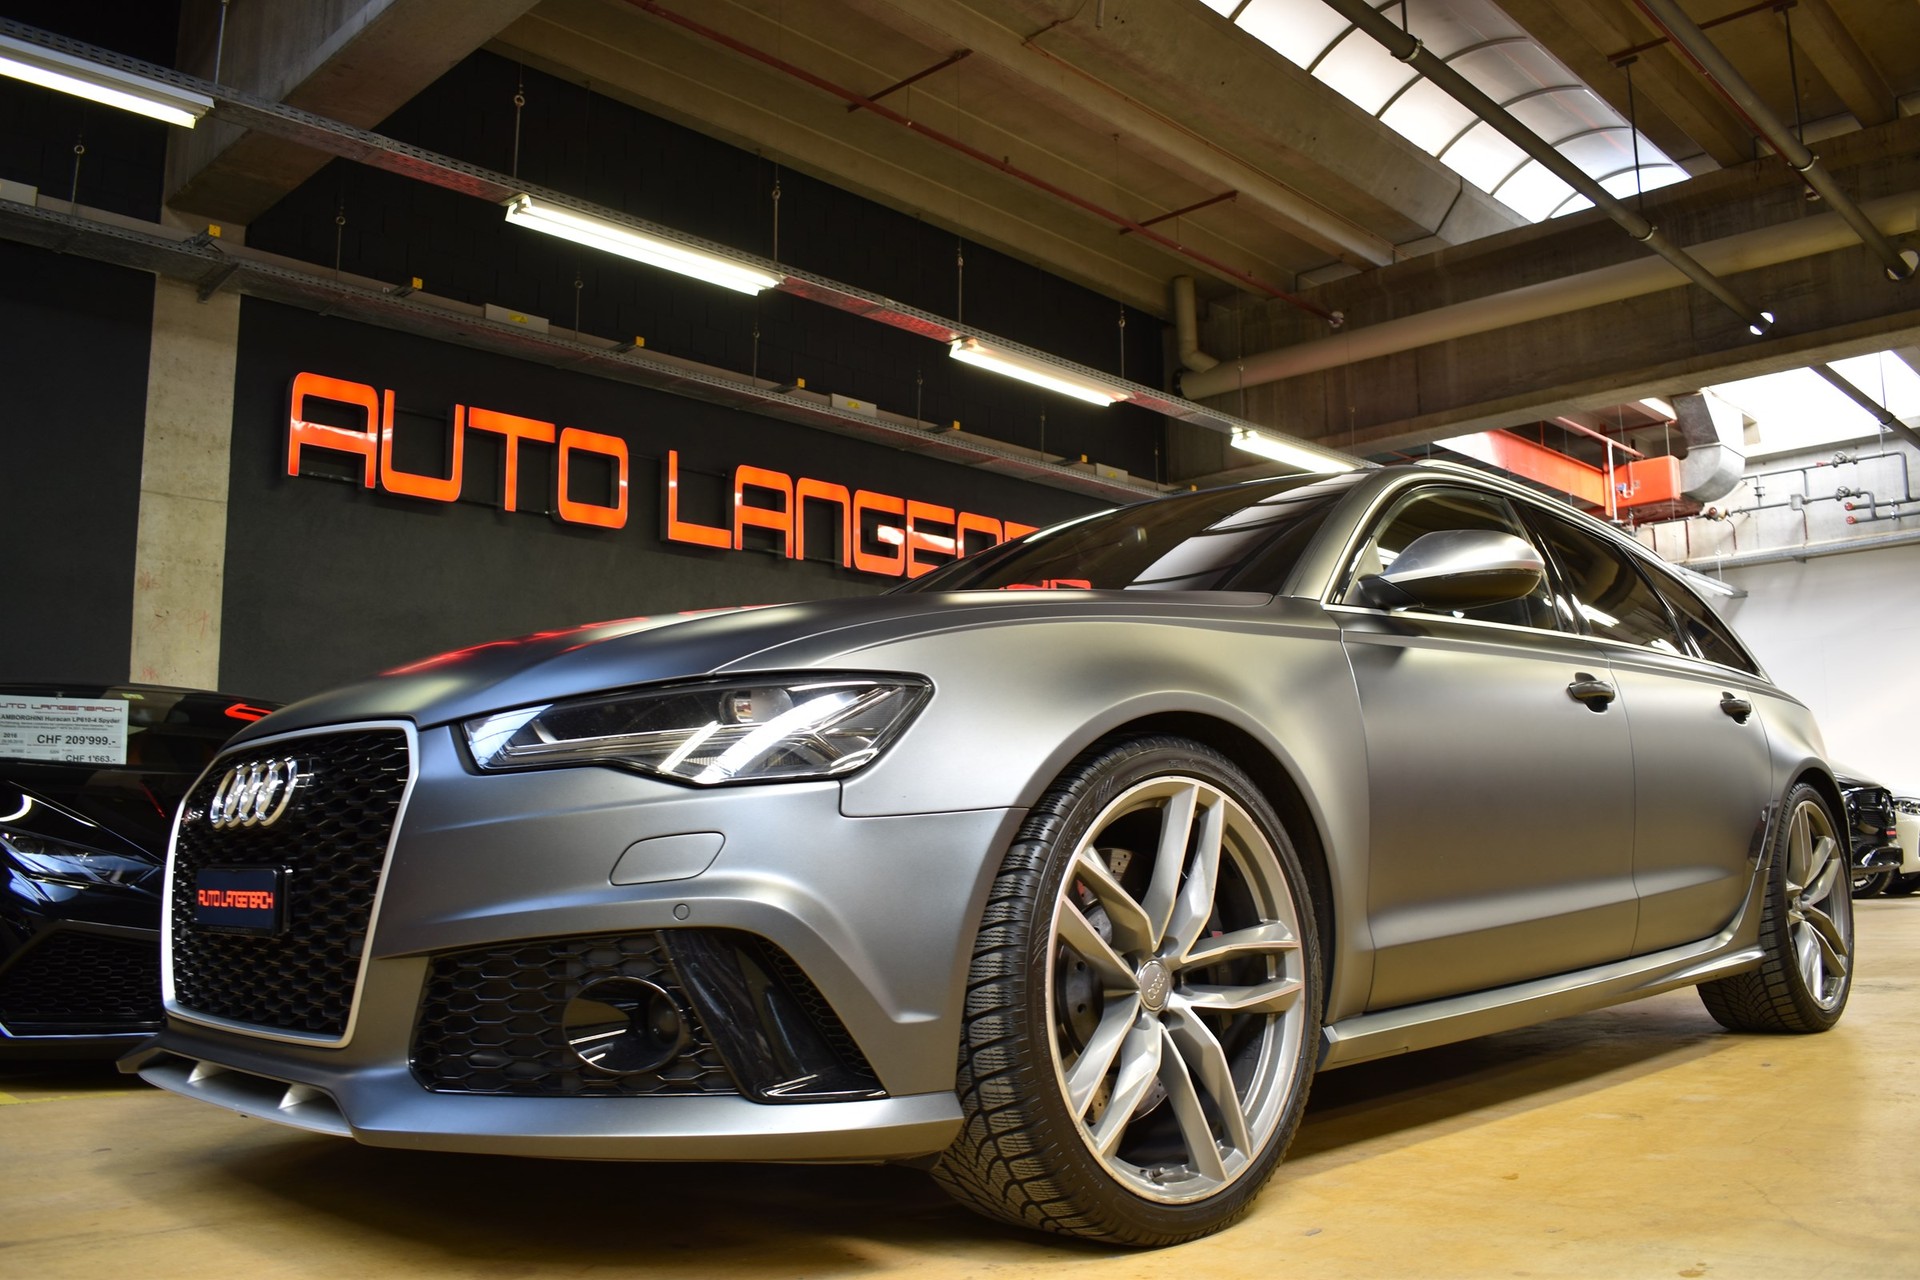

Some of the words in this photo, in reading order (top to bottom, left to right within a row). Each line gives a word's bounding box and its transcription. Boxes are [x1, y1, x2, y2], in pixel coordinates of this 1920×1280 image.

[287, 371, 628, 529] AUTO
[661, 449, 1041, 579] LANGEN
[31, 704, 122, 712] LANGENBACH
[37, 734, 62, 744] CHF
[65, 735, 116, 746] 209'999.-
[198, 889, 220, 907] AUTO
